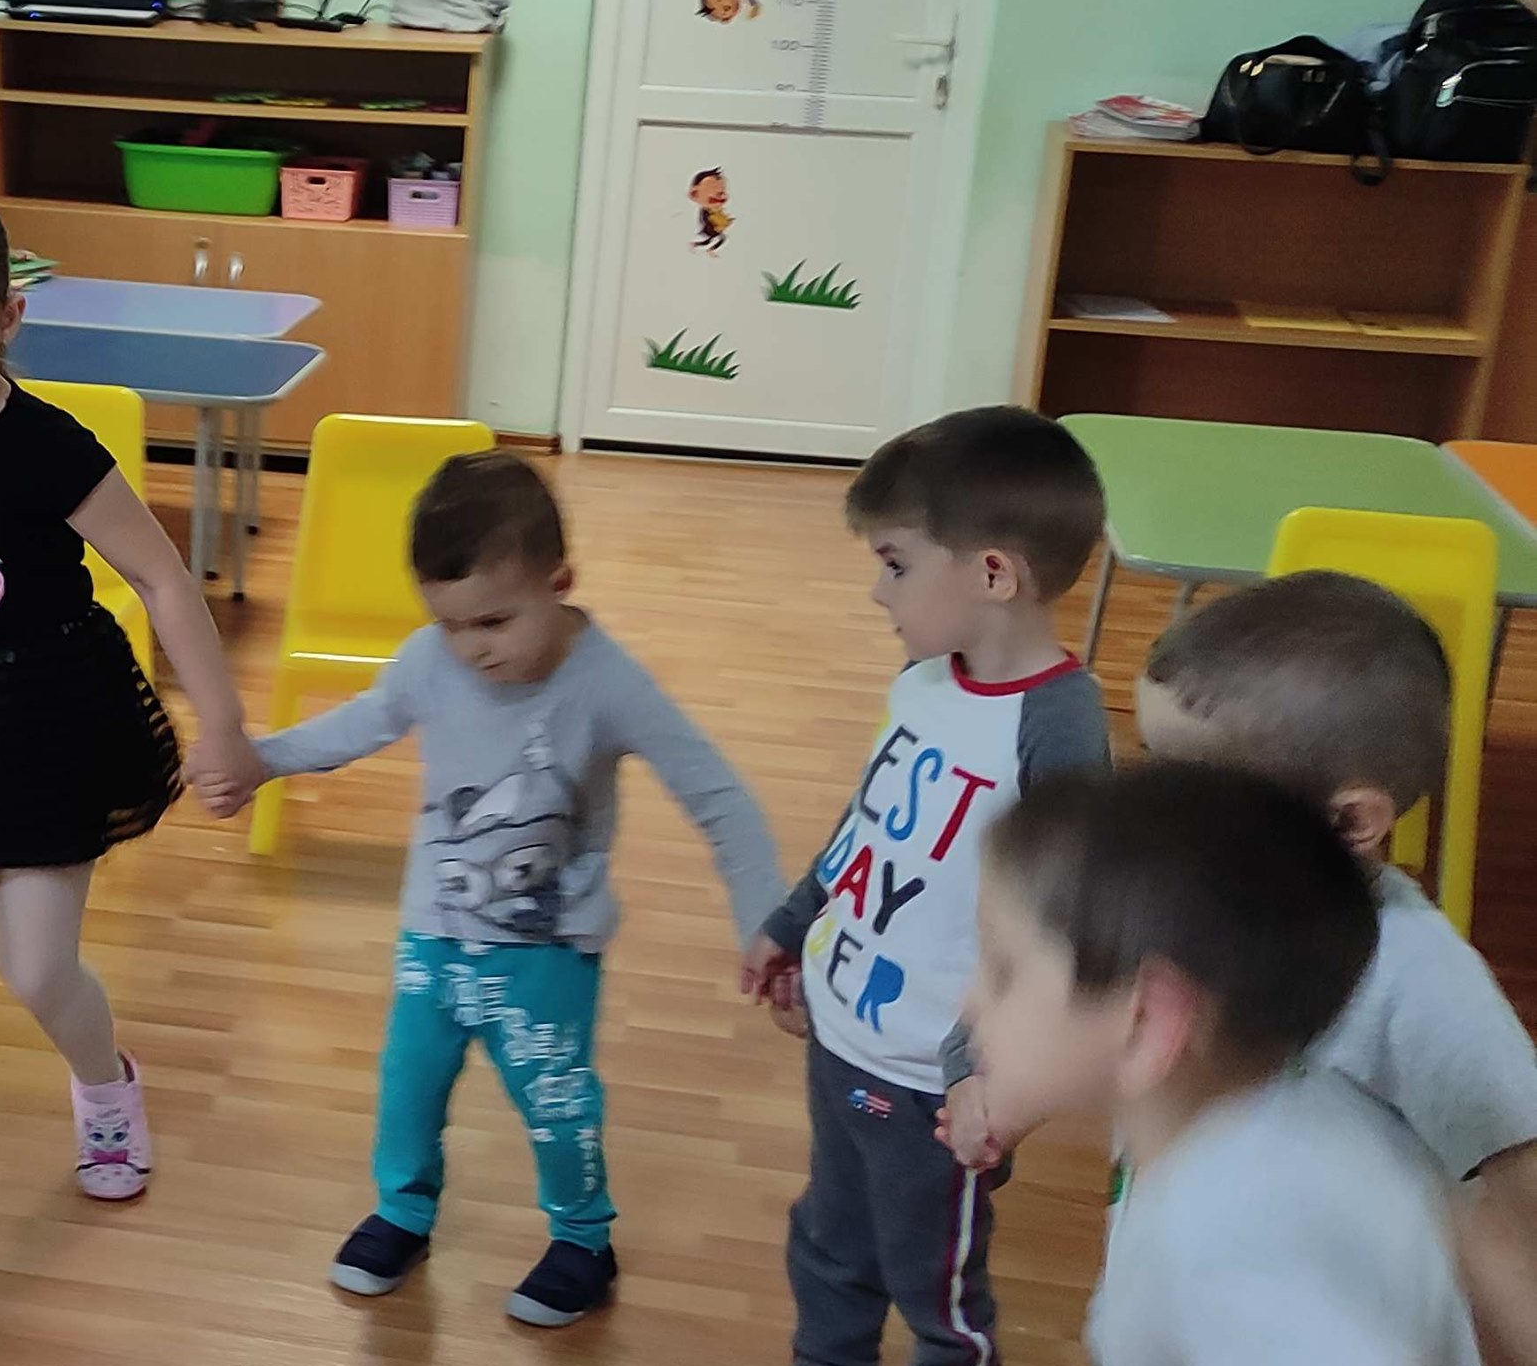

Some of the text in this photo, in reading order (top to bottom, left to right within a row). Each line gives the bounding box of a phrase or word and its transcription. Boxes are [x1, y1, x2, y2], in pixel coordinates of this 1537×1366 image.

[771, 39, 800, 51] 100
[859, 715, 997, 862] EST
[816, 823, 926, 935] DAY
